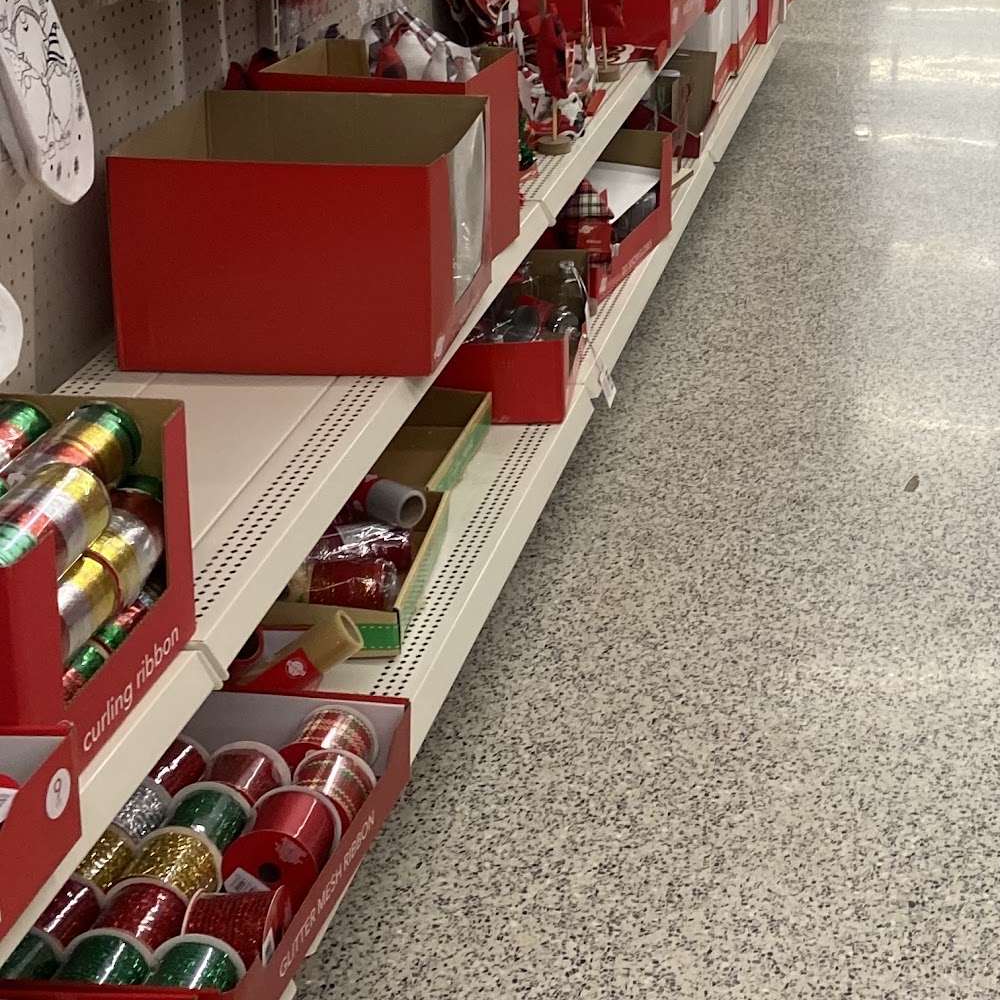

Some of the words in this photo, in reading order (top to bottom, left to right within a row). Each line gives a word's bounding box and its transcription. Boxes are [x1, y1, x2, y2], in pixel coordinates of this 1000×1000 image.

[82, 682, 134, 752] curling
[135, 626, 180, 689] ribbon
[279, 906, 317, 978] GLITTER
[317, 868, 343, 916] MESH
[343, 809, 375, 873] RIBBON
